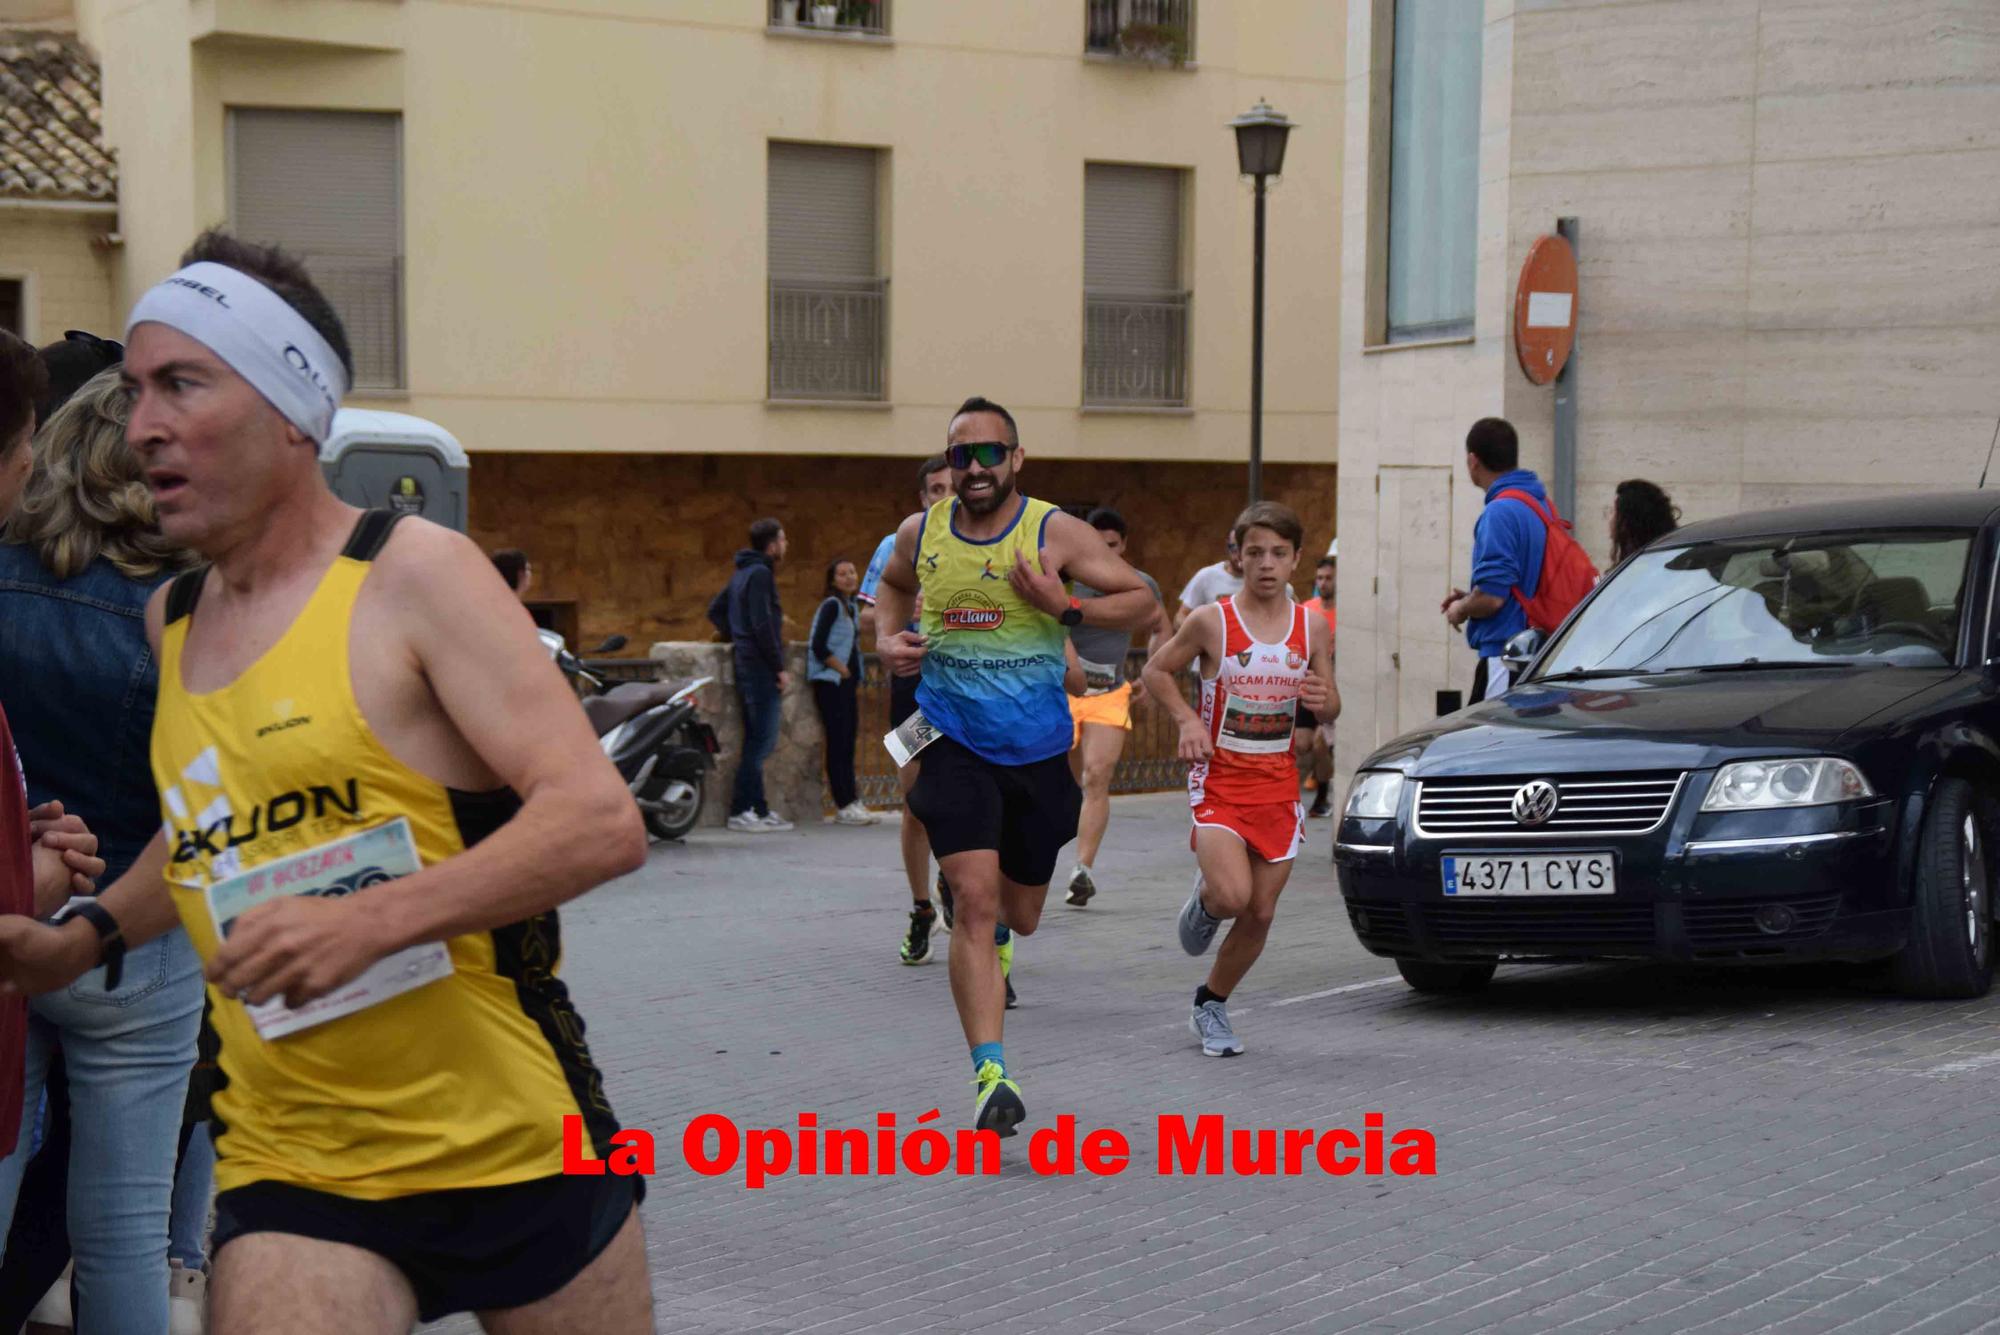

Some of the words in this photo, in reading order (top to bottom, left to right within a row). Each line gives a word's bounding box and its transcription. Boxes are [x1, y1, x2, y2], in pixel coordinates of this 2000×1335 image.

[957, 658, 979, 670] DE
[983, 654, 1045, 670] BRUJAS
[1230, 675, 1264, 685] UCAM
[1266, 676, 1298, 687] ATHLE
[1461, 860, 1530, 890] 4371
[1546, 859, 1604, 889] CYS
